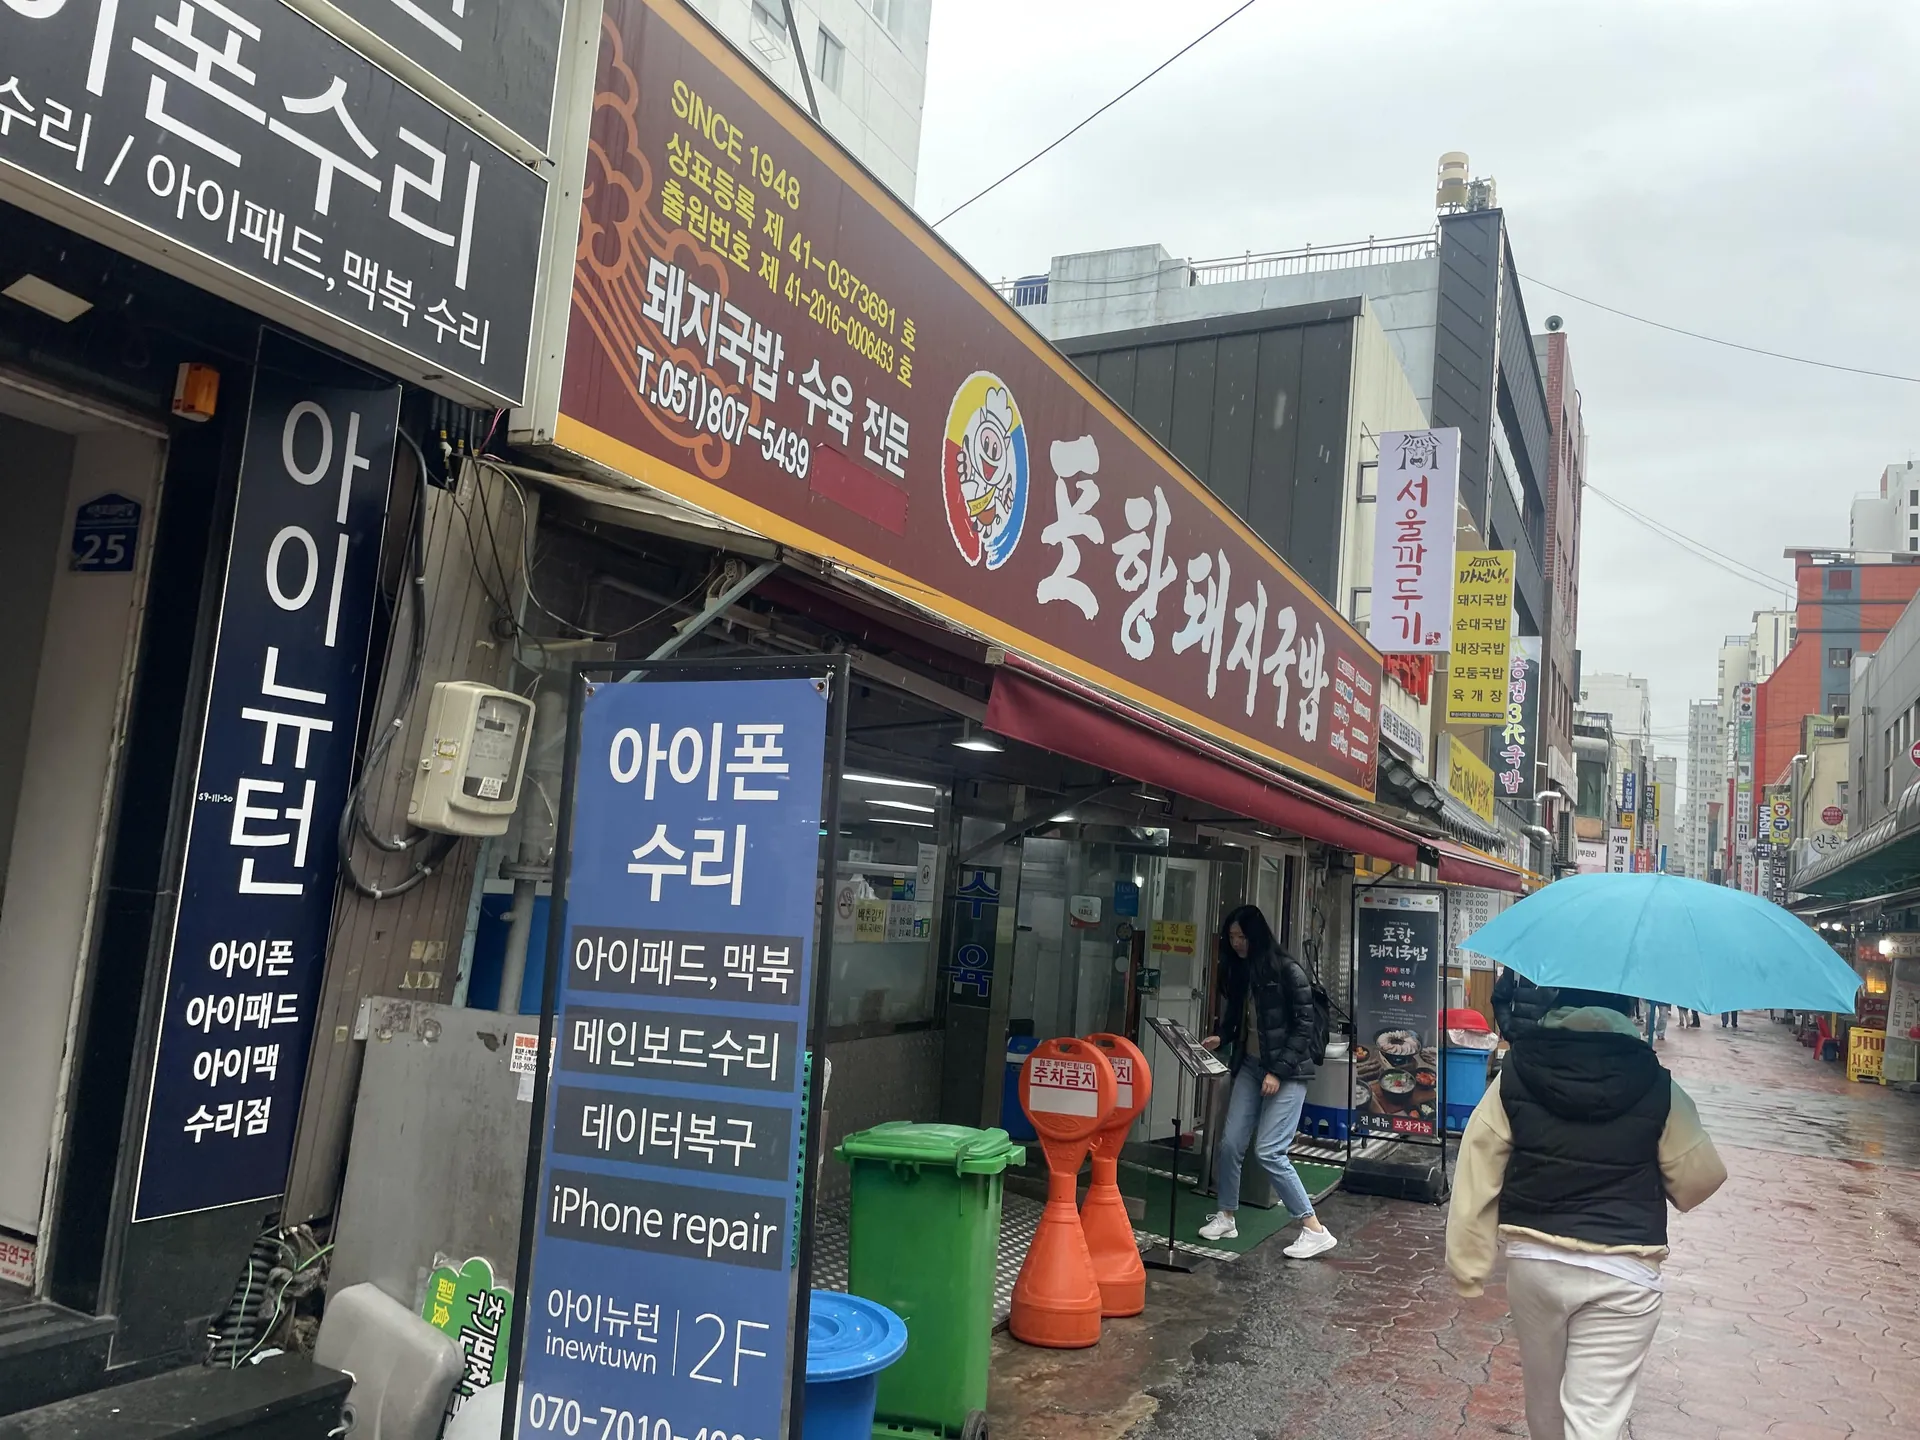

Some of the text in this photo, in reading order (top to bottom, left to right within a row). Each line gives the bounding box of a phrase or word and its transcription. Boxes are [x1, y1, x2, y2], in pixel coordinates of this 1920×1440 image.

[671, 80, 801, 211] SINCE 1948
[146, 154, 337, 292] 아이패드,
[343, 250, 416, 327] 맥북
[424, 298, 490, 365] 수리
[667, 132, 916, 352] 상표등록 제 41-0373691 호
[660, 178, 913, 389] 출원번호 제 41-2016-0006453 호
[635, 345, 811, 480] T.051)807-5439
[862, 396, 910, 479] 전문
[76, 534, 126, 565] 25
[1391, 475, 1428, 645] 서울깍두기
[1460, 567, 1508, 584] 마선생
[1457, 594, 1507, 606] 돼지국밥
[230, 401, 370, 895] 아이뉴턴
[1456, 618, 1506, 631] 순대국밥
[1455, 642, 1505, 655] 내장국밥
[1453, 667, 1504, 680] 모둠국밥
[609, 722, 790, 801] 아이폰
[627, 824, 747, 906] 수리
[1814, 834, 1840, 849] 신촌
[209, 940, 294, 978] 아이폰
[1369, 944, 1428, 961] 돼지국밥
[1383, 927, 1415, 944] 포항
[575, 936, 794, 994] 아이패드, 맥북
[186, 992, 299, 1034] 아이패드
[193, 1044, 279, 1087] 아이맥
[573, 1018, 778, 1081] 메인보드수리
[1054, 1060, 1092, 1071] 부탁드립니다
[1033, 1066, 1096, 1088] 주차금지
[184, 1096, 271, 1144] 수리점
[582, 1103, 757, 1167] 데이터복구
[1360, 1115, 1431, 1133] 전 메뉴 포장가능
[552, 1185, 777, 1257] iPhone repair
[548, 1290, 660, 1343] 아이뉴턴
[546, 1329, 656, 1375] inewtuwn
[690, 1312, 770, 1387] 2F
[530, 1393, 763, 1440] 070-7010-
